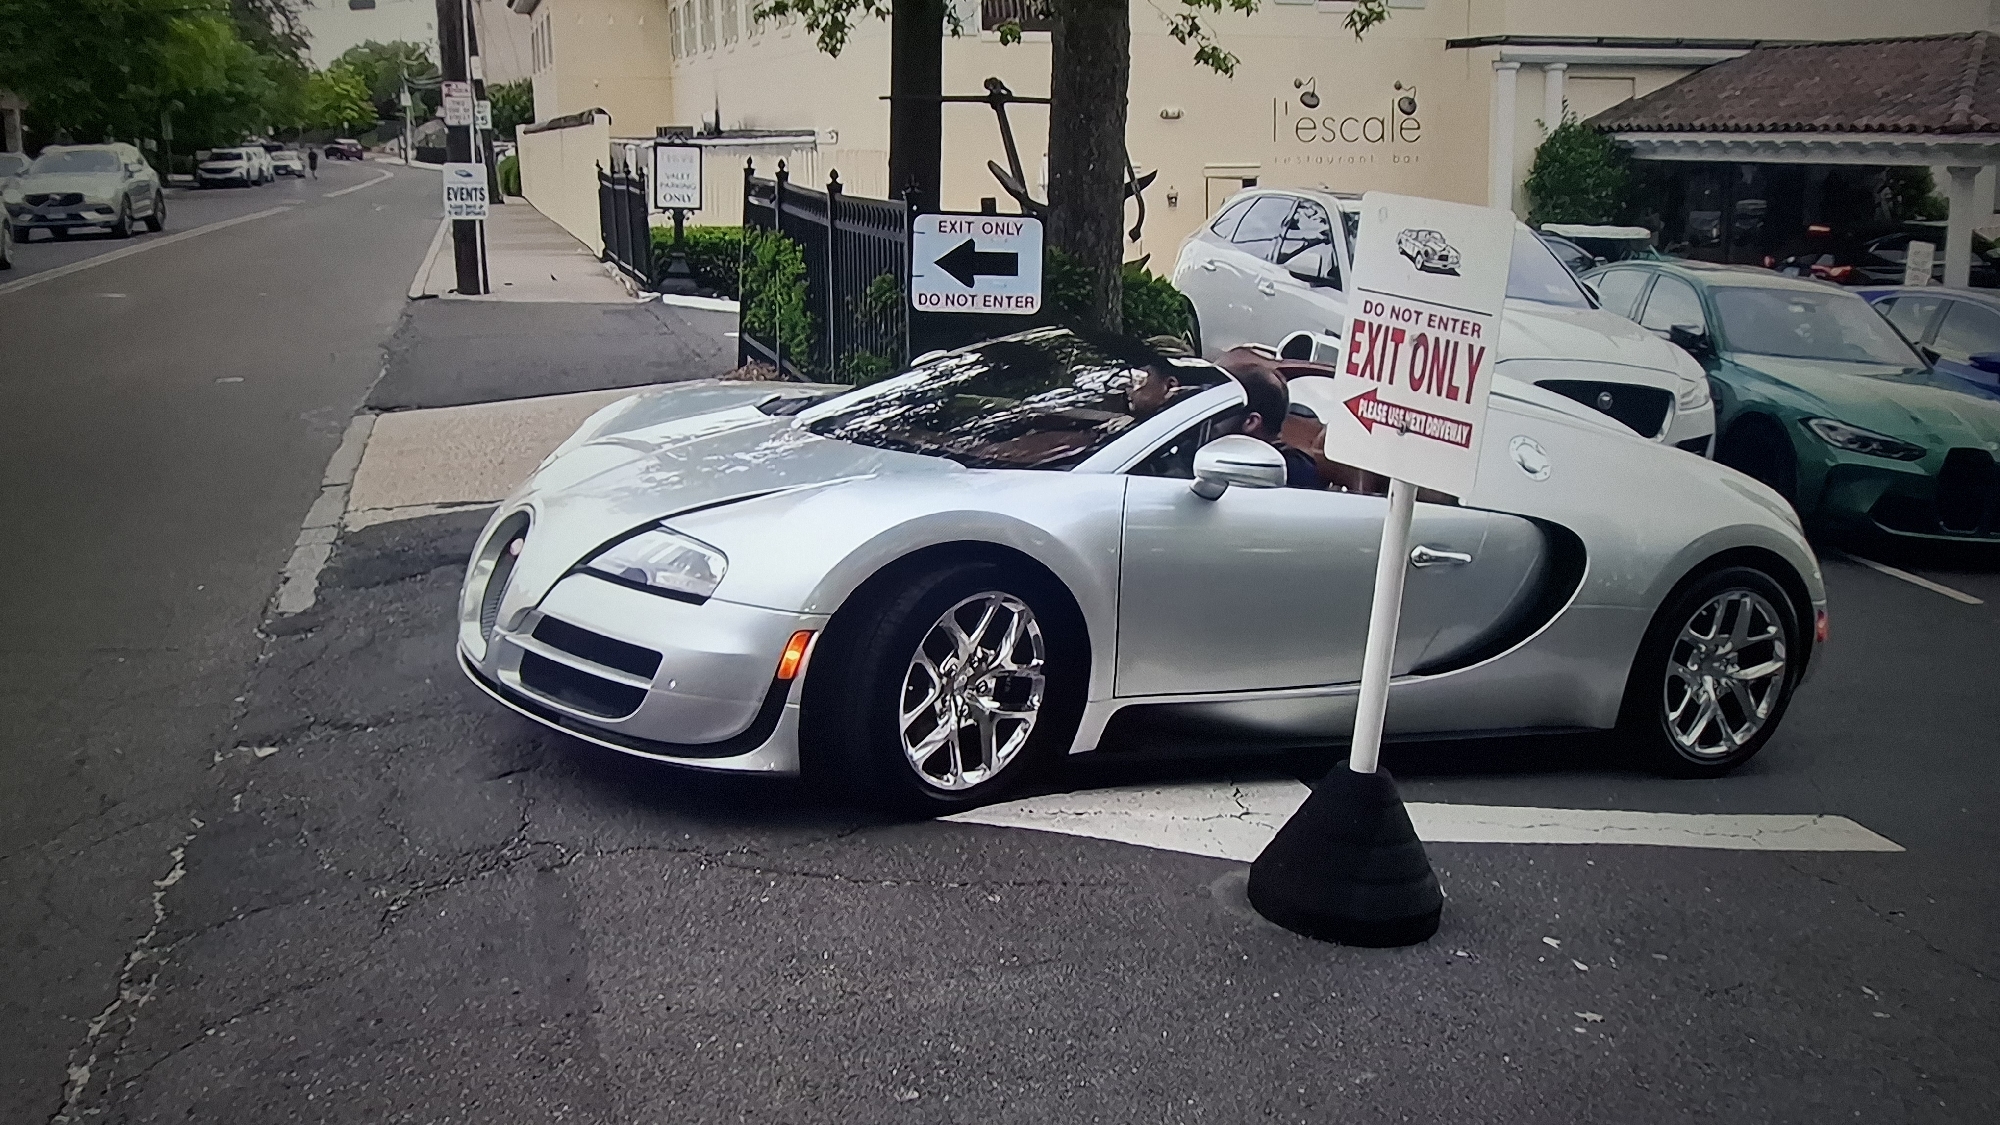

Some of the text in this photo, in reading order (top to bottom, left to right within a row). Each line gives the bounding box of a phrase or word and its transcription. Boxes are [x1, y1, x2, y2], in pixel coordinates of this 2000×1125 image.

[1273, 97, 1421, 143] l'escale
[1392, 154, 1420, 164] bar
[446, 186, 486, 202] EVENTS
[663, 193, 694, 203] ONLY
[938, 220, 1024, 236] EXIT ONLY
[918, 293, 1035, 309] DO NOT ENTER
[1363, 299, 1482, 339] DO NOT ENTER
[1345, 318, 1486, 404] EXIT ONLY
[1358, 398, 1470, 445] PLEASE USE NEXT DRIVEWAY
